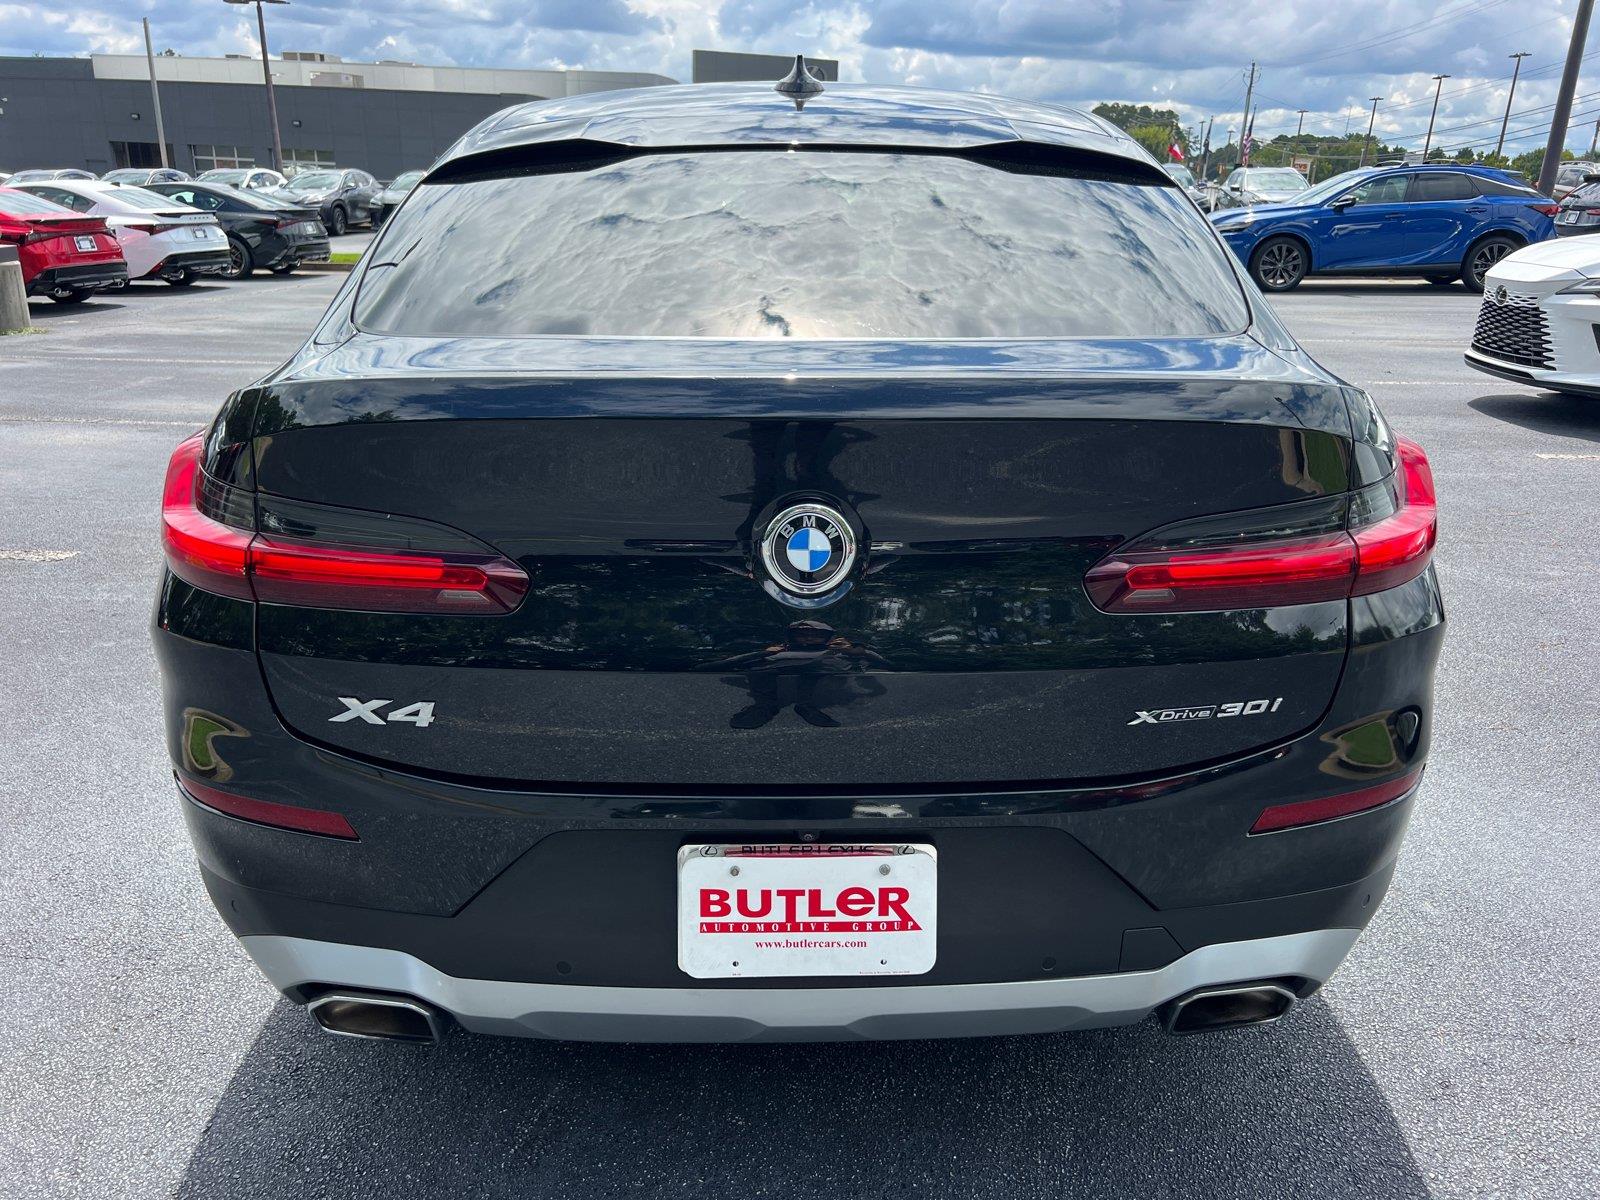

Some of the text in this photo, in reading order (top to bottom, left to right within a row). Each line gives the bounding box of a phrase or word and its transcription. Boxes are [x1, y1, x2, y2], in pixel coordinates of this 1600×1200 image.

[779, 515, 840, 539] BMW
[327, 696, 435, 727] X4
[701, 921, 914, 932] AUTOMOTIVE GROUP
[755, 938, 867, 949] www.butlercars.com
